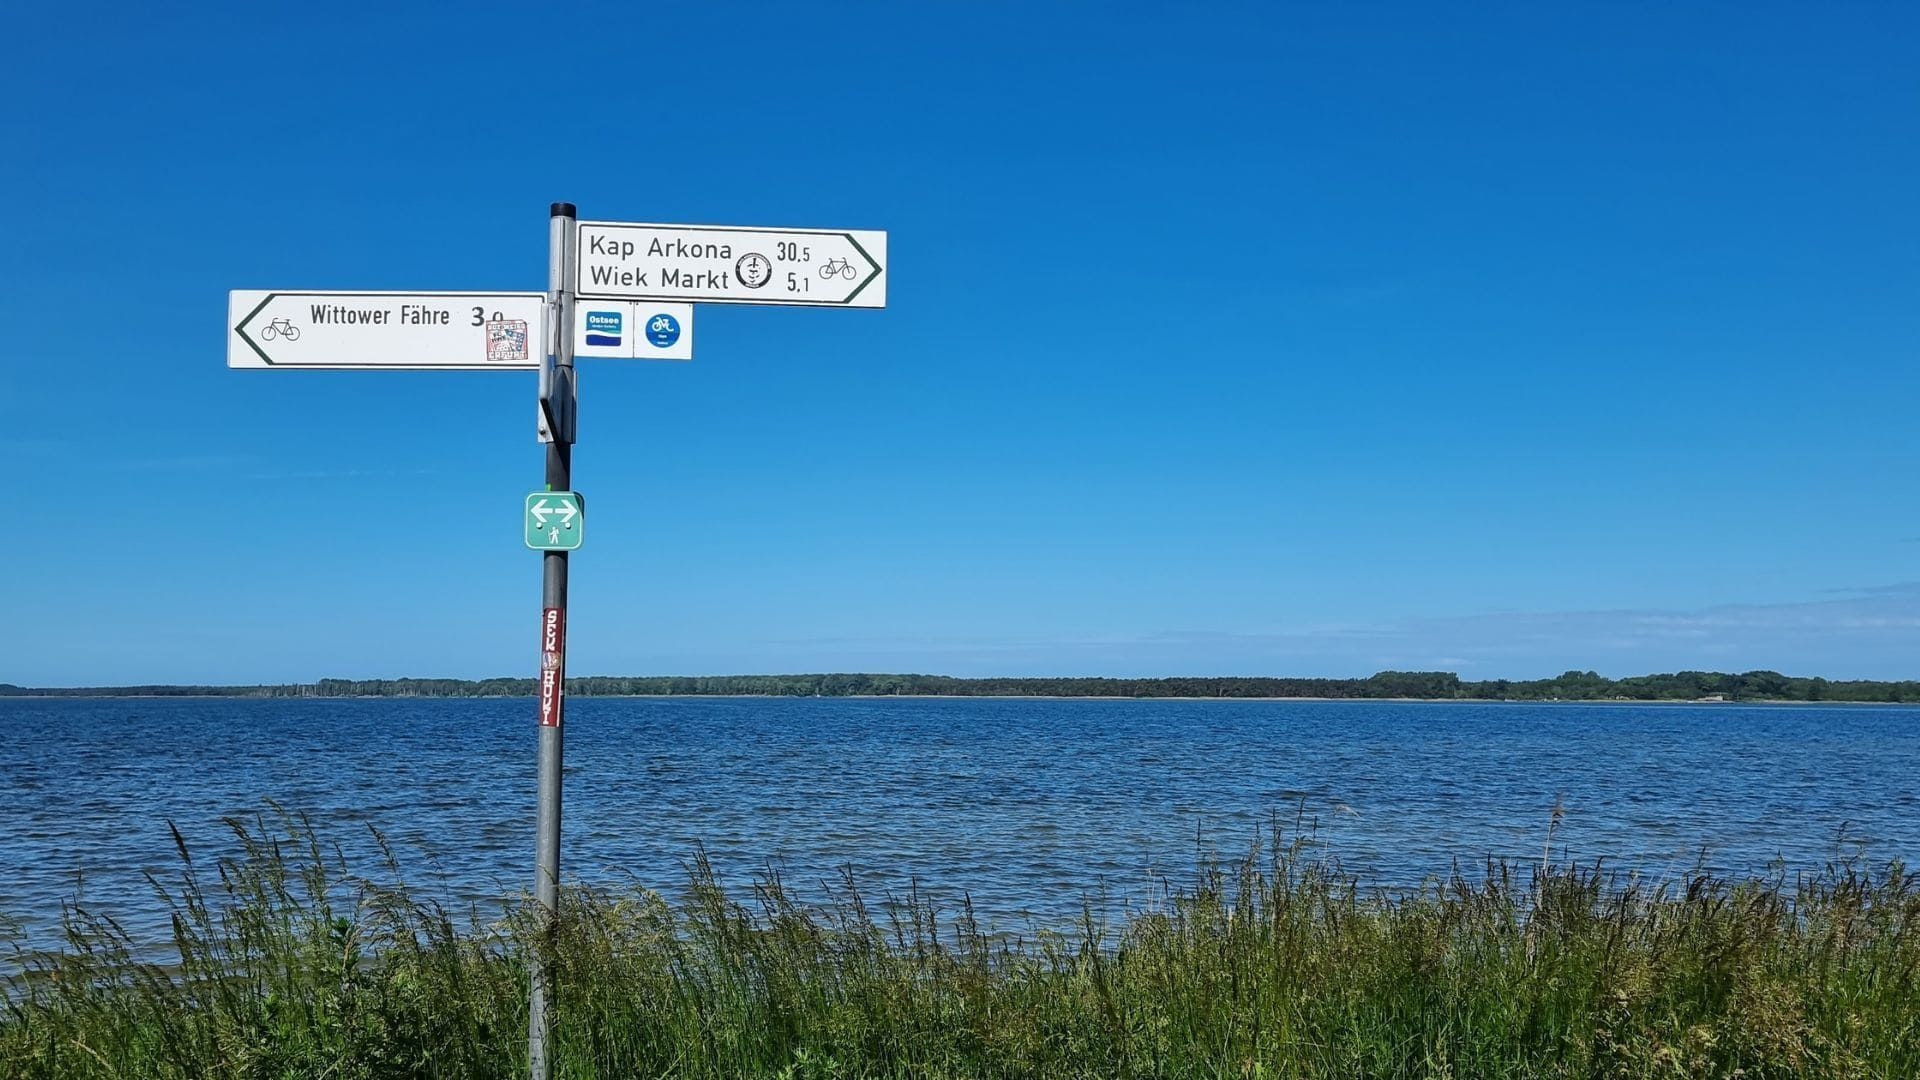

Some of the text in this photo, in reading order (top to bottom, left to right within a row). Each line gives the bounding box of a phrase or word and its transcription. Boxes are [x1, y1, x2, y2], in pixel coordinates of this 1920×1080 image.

[590, 235, 634, 261] Kap
[647, 237, 732, 260] Arkona
[590, 265, 648, 287] Wiek
[661, 268, 729, 290] Markt
[310, 304, 391, 325] Wittower
[401, 304, 450, 325] Fähre
[589, 316, 620, 325] Ostsee
